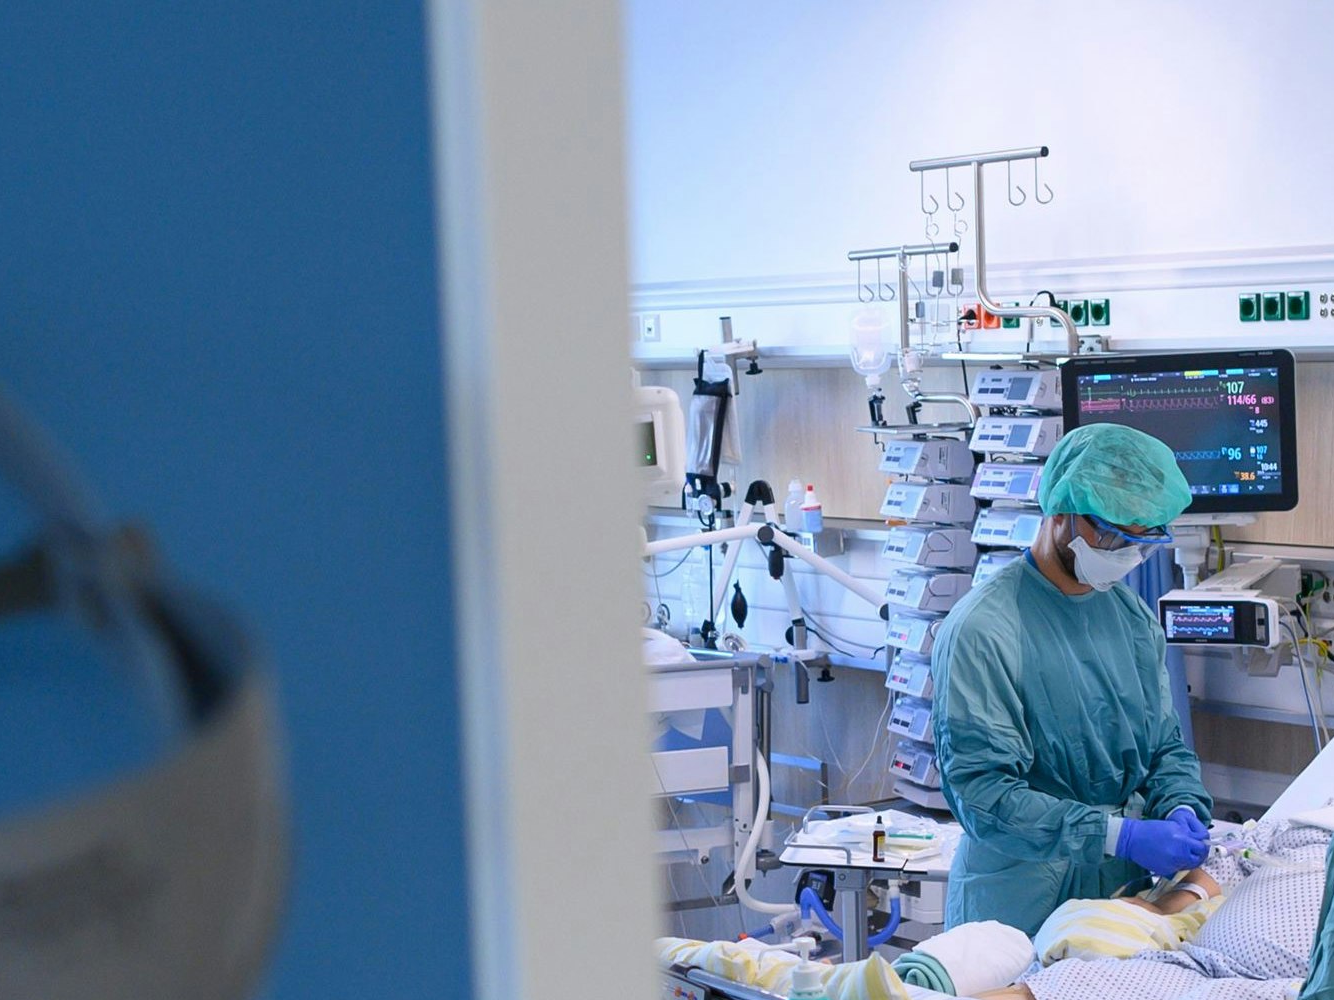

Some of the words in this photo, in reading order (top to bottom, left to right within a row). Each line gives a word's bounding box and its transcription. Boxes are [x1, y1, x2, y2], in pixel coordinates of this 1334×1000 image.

[1227, 381, 1244, 394] 107
[1227, 395, 1257, 405] 114/66
[1228, 447, 1242, 460] 96
